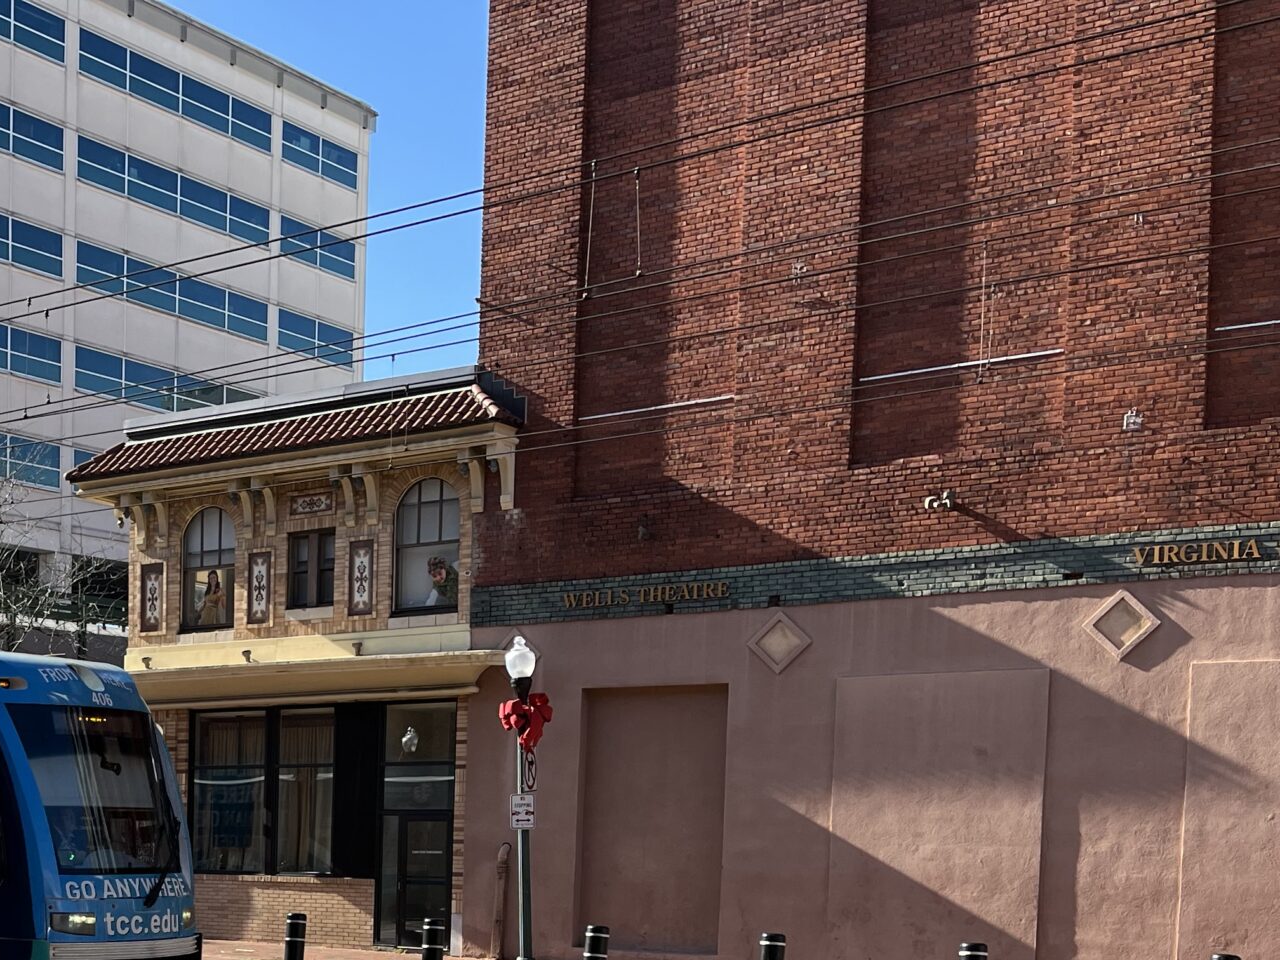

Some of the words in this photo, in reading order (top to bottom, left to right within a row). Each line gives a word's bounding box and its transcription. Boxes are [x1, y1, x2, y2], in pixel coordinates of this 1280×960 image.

[1132, 538, 1262, 566] VIRGINIA
[563, 588, 629, 609] WELLS
[637, 581, 730, 603] THEATRE
[92, 692, 113, 706] 406
[65, 880, 96, 899] GO
[103, 908, 179, 935] tcc.edu
